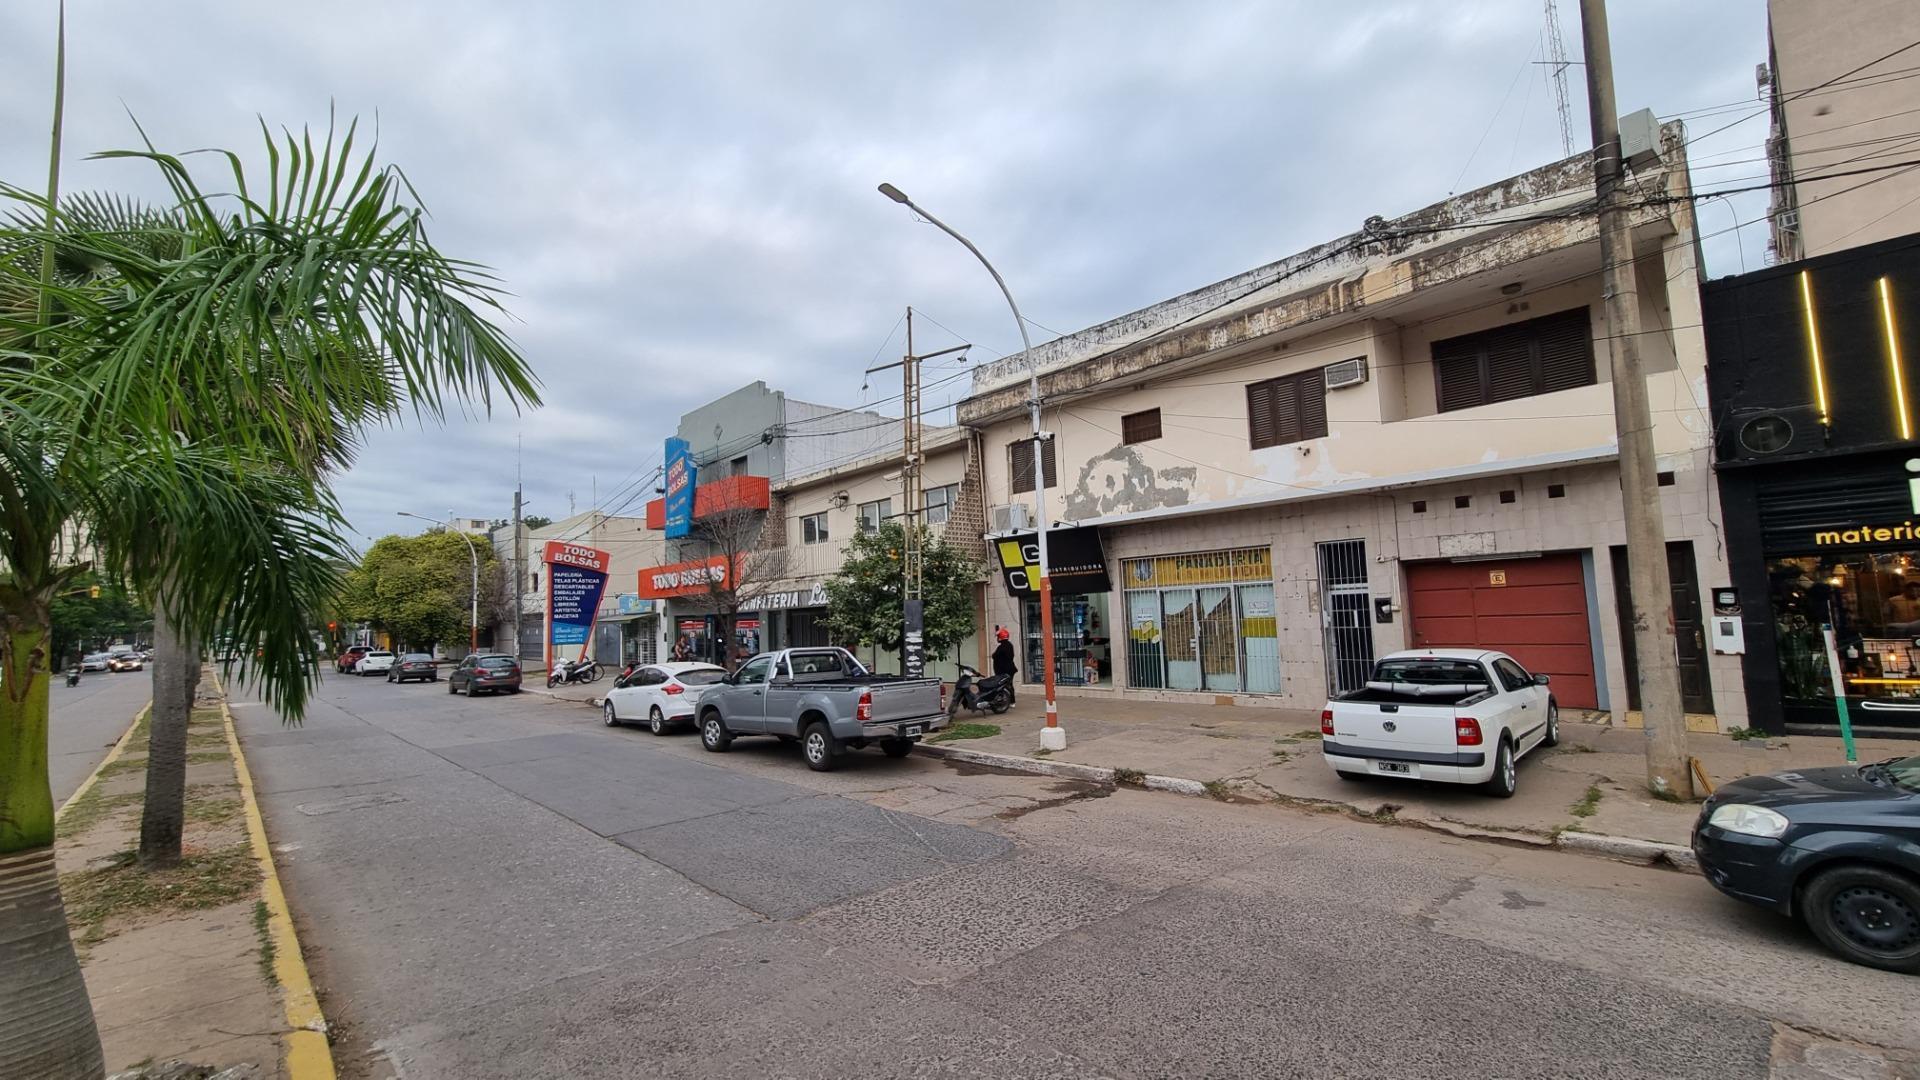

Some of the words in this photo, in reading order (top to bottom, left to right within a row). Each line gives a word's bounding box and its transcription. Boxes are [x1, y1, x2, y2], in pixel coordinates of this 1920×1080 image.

[669, 461, 683, 481] TODO
[668, 471, 688, 497] BOLSAS
[554, 552, 601, 569] BOLSAS
[563, 545, 596, 559] TODO
[1022, 544, 1040, 563] G
[652, 572, 678, 590] TODO
[1010, 571, 1029, 589] C
